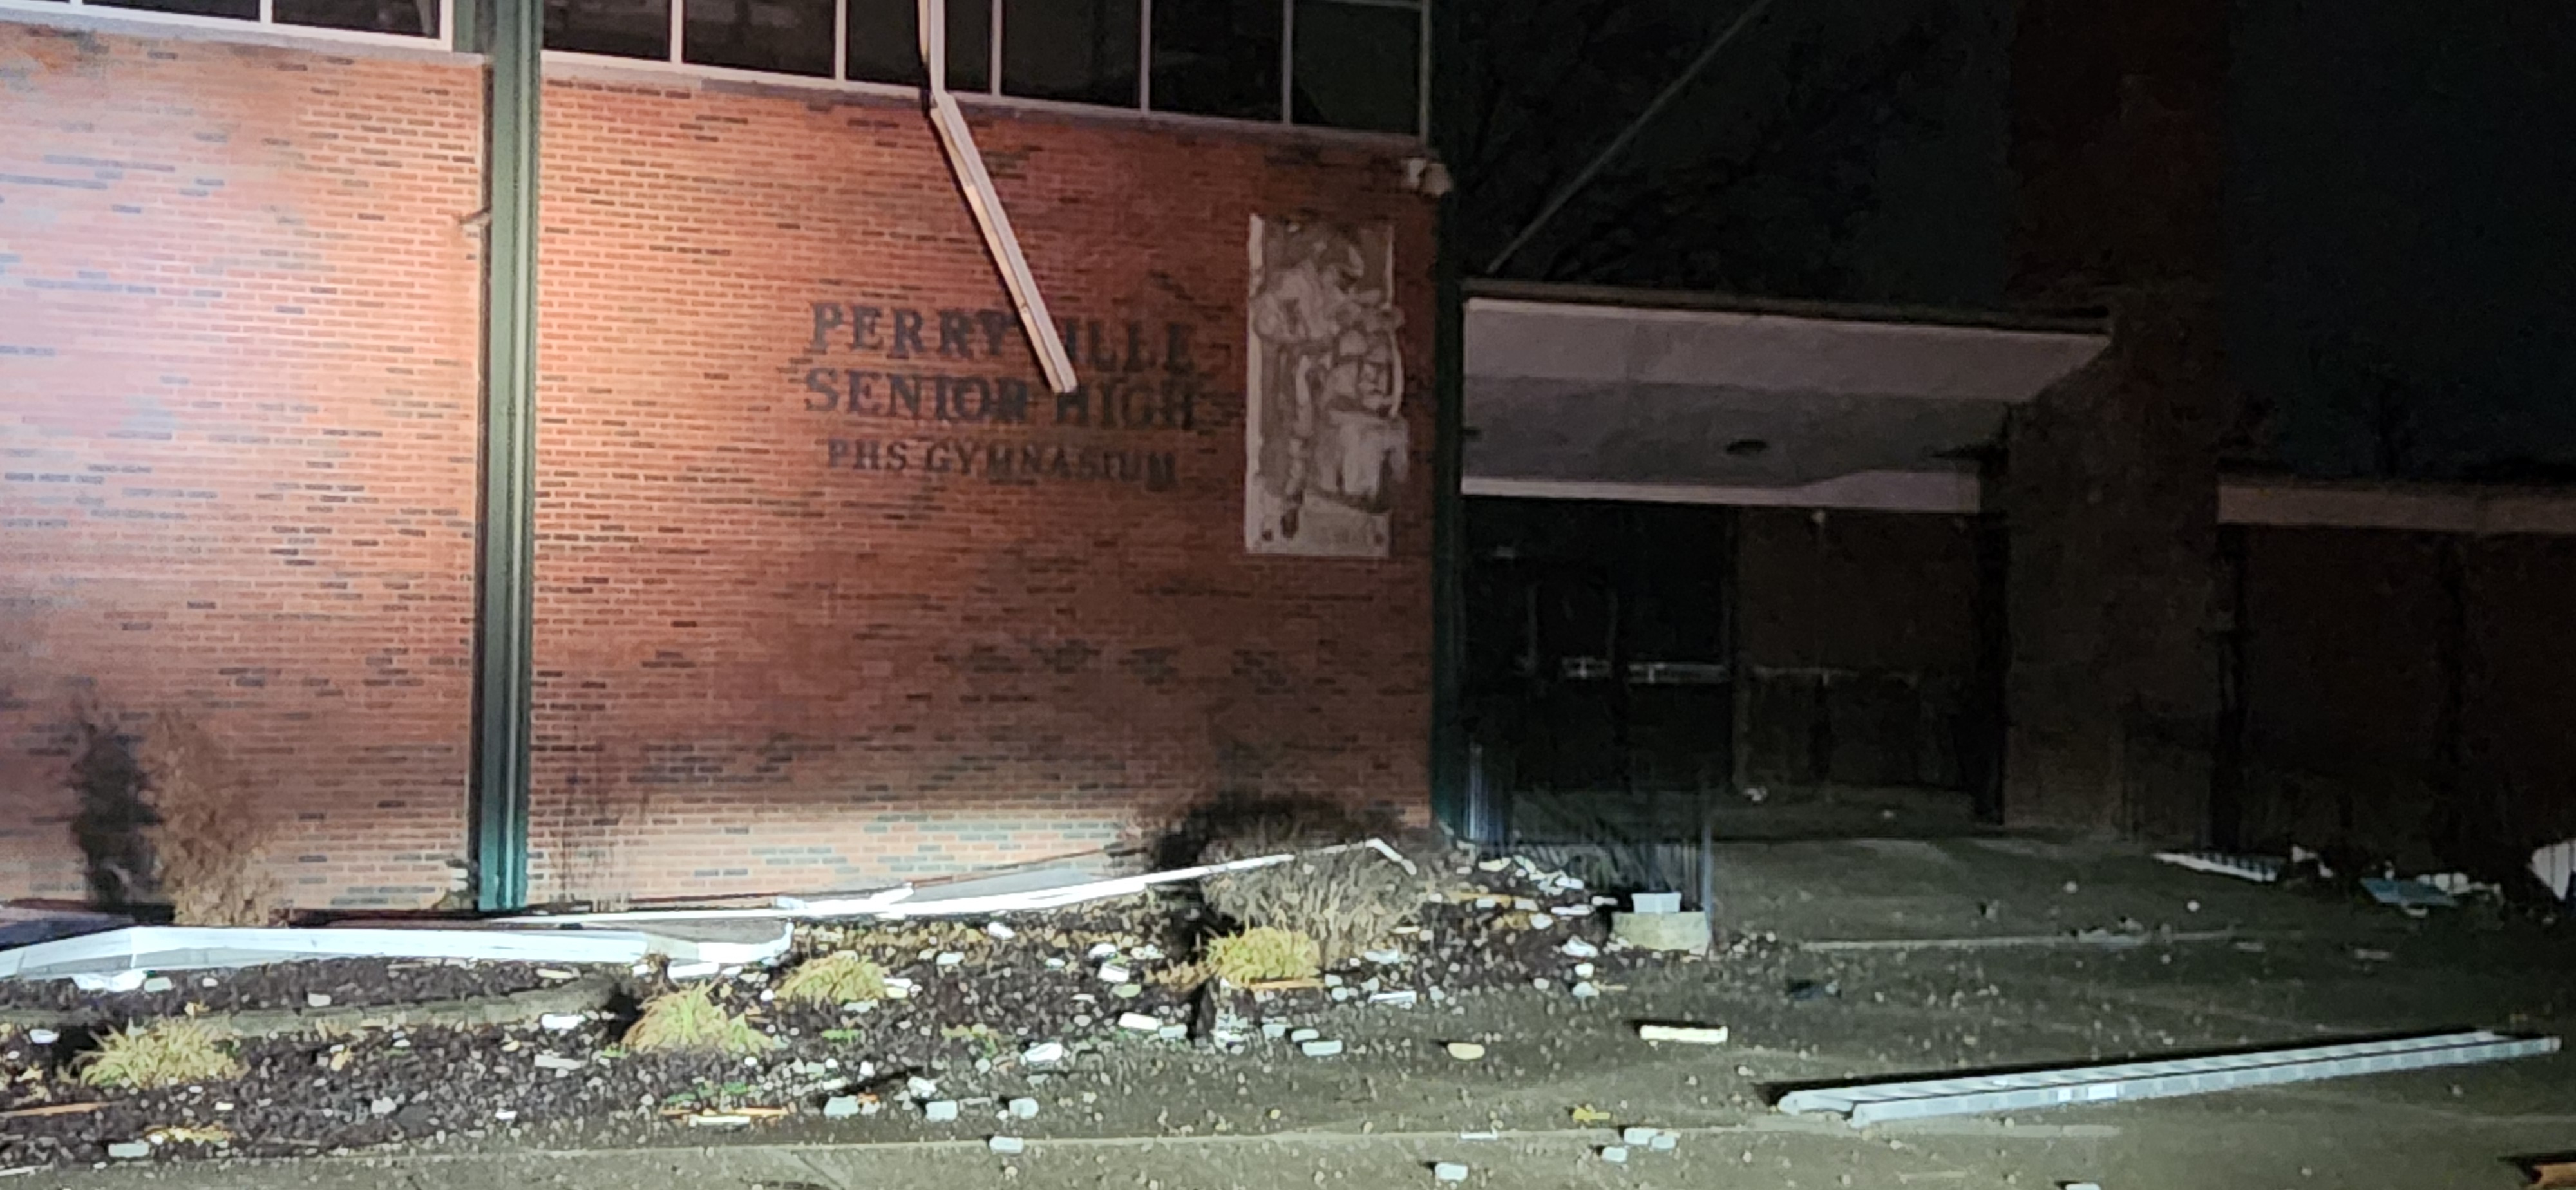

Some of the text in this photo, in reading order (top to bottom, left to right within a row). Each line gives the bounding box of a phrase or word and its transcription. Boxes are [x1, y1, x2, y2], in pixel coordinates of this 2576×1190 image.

[804, 300, 1197, 375] PERRYILLE
[804, 367, 1197, 430] SENIOR HIGH
[826, 438, 1177, 492] PHS GYMNASIUM
